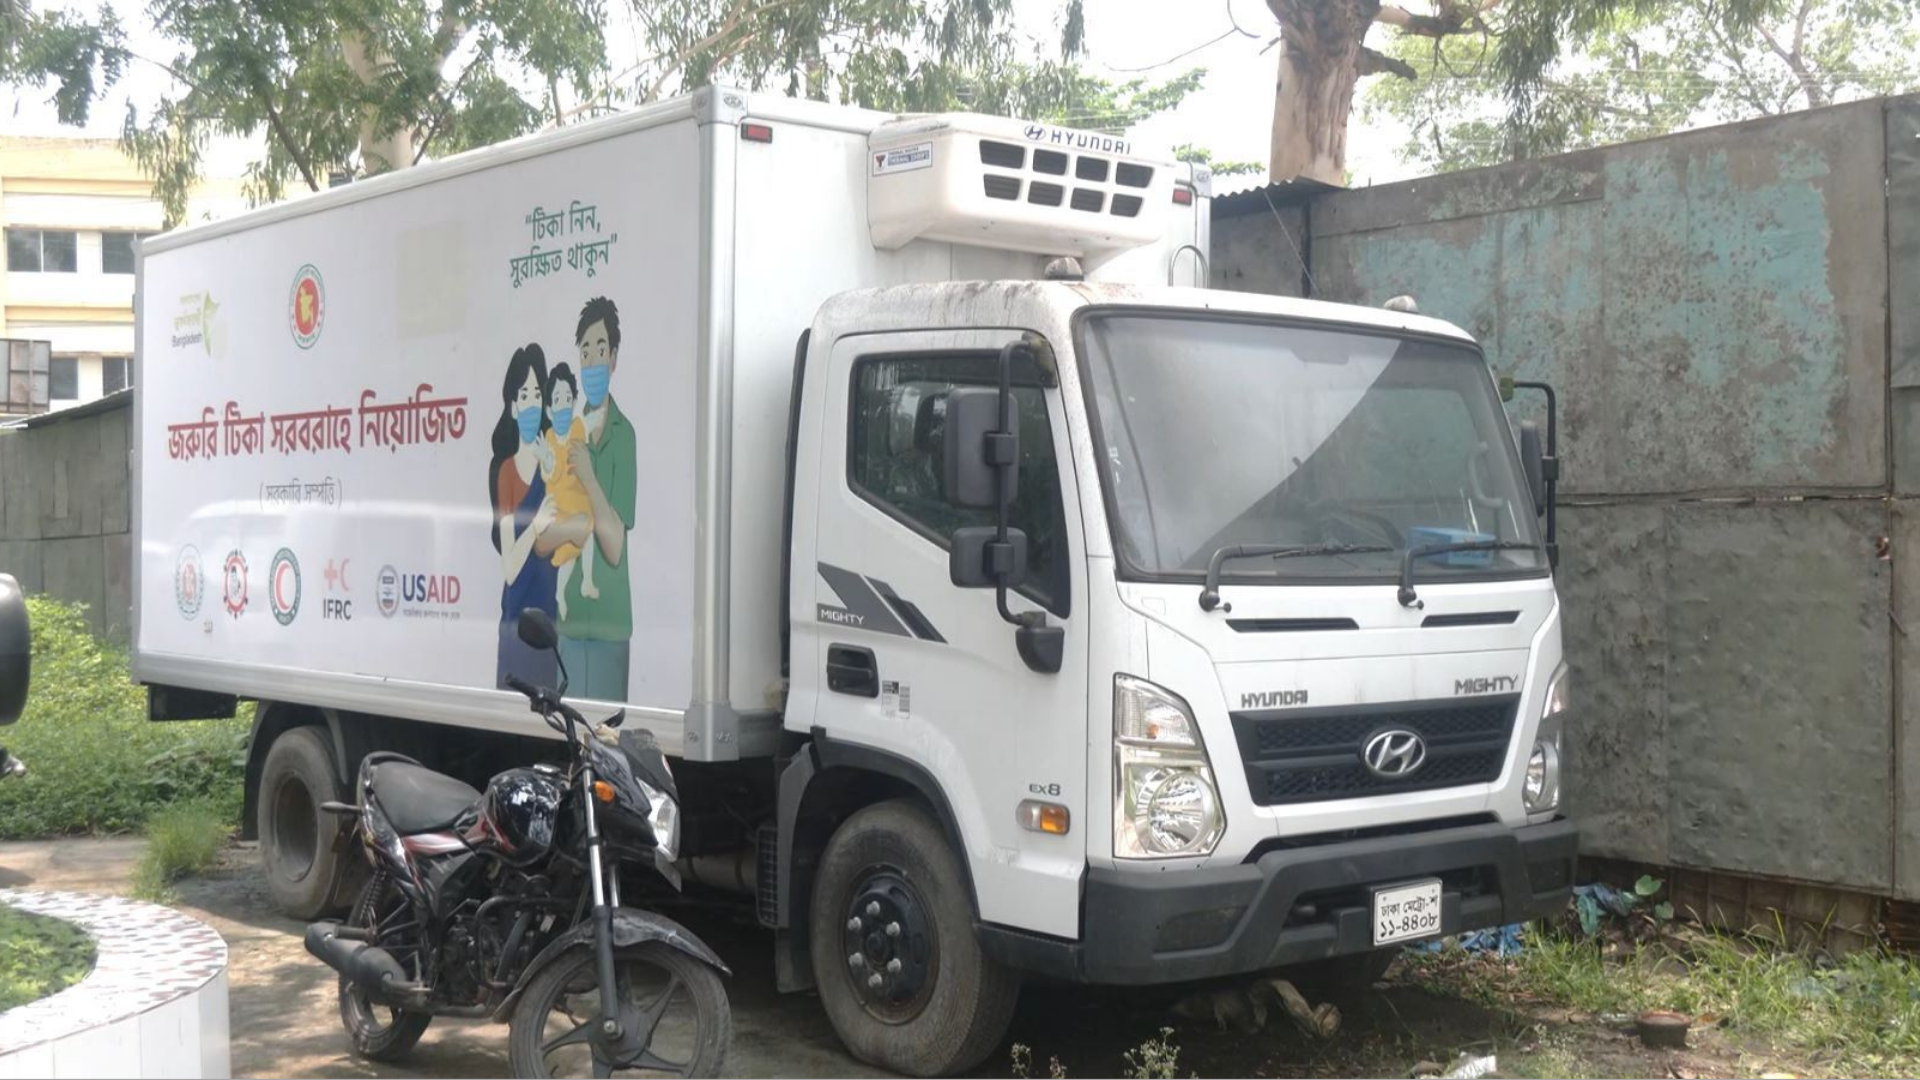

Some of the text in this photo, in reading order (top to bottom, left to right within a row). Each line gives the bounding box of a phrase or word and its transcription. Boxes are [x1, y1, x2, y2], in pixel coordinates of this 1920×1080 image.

[1051, 129, 1131, 155] HYUNDAI
[568, 200, 601, 234] নিন,
[509, 245, 562, 288] সুরক্ষিত
[168, 383, 468, 461] জরুরি টিকা সরবরাহে নিয়োজিত
[402, 574, 461, 604] USAID
[323, 598, 352, 620] IFRC
[820, 608, 864, 625] MIGHTY
[1454, 675, 1519, 695] MIGHTY
[1241, 690, 1308, 708] HYUNDAI
[1029, 783, 1061, 797] EX8
[1381, 902, 1401, 917] ঢাকা
[1380, 912, 1438, 938] ১১-৪৪০৮
